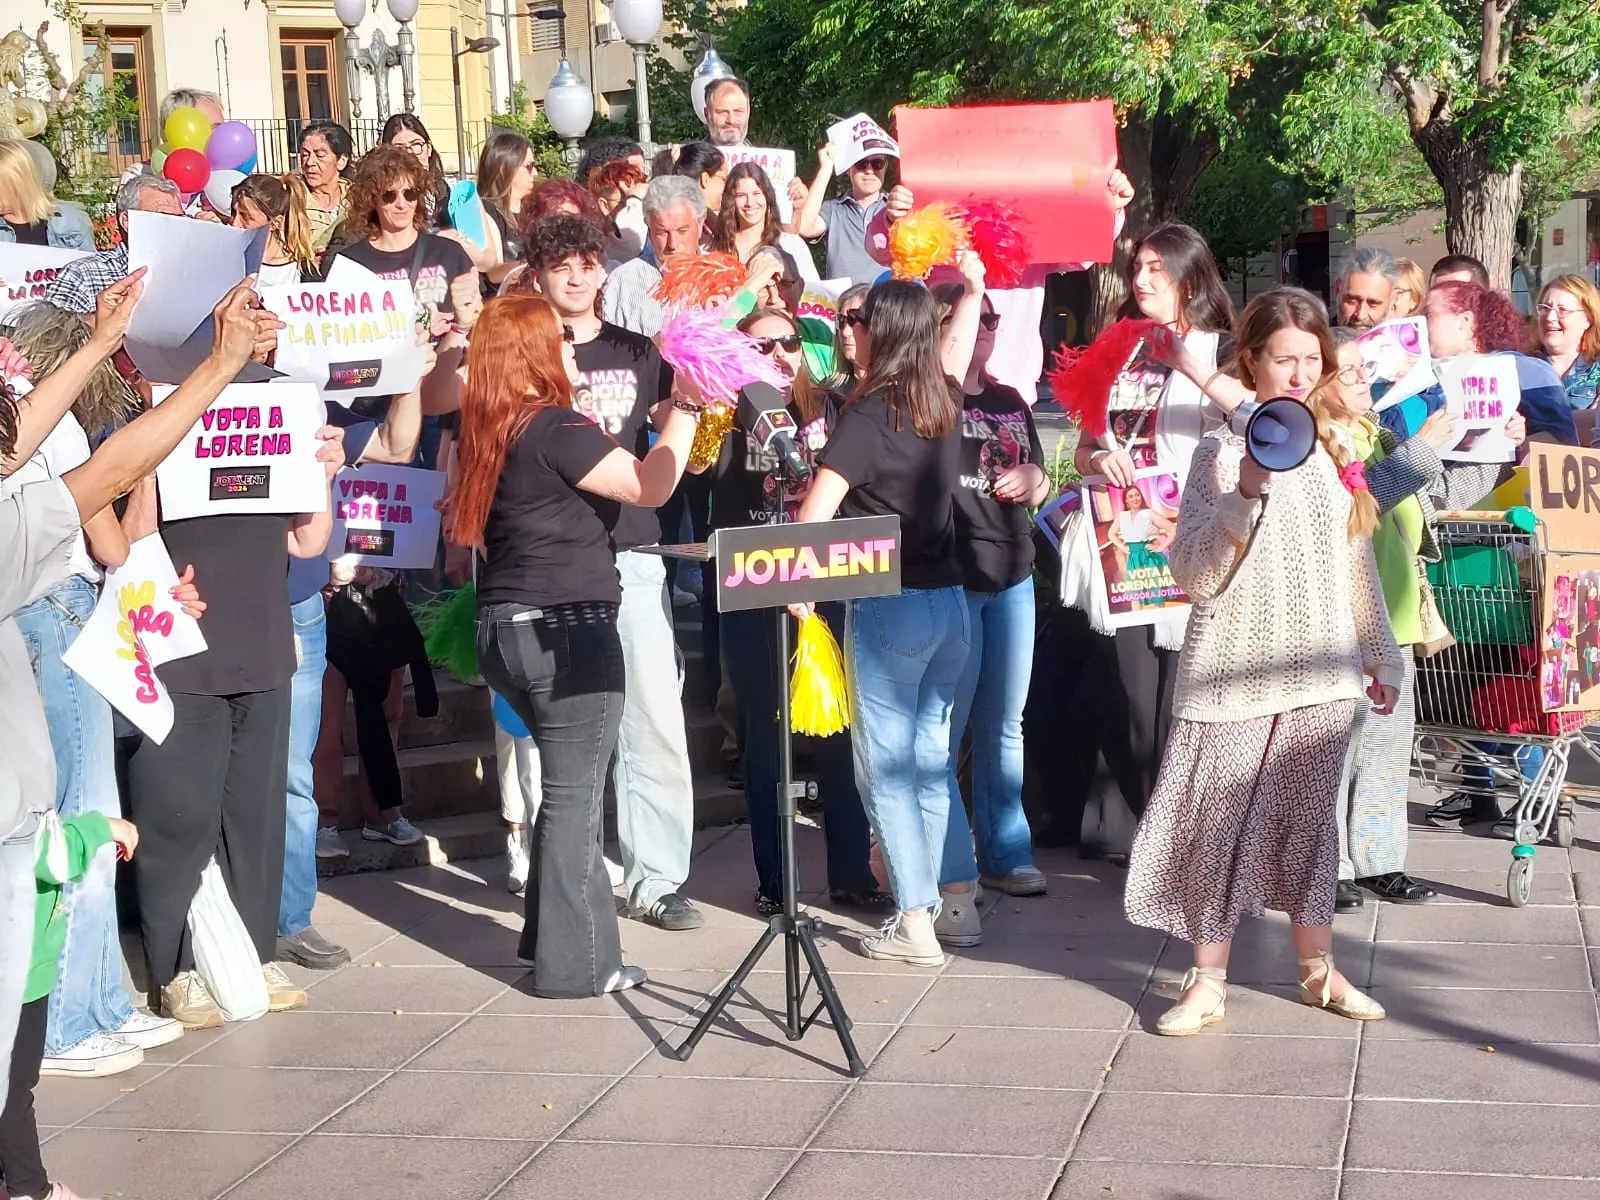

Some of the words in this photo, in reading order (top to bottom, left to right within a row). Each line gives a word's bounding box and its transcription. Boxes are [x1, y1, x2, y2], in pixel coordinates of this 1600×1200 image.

[287, 291, 372, 317] LORENA
[383, 290, 395, 311] A
[288, 321, 316, 346] LA
[591, 370, 638, 384] MATA
[201, 406, 261, 431] VOTA
[268, 405, 284, 429] A
[195, 433, 292, 458] LORENA
[213, 474, 266, 487] JOTALENT
[339, 480, 389, 499] VOTA
[394, 484, 407, 502] A
[1538, 454, 1600, 514] LOR
[336, 501, 413, 524] LORENA
[724, 538, 896, 588] JOTALENT
[1128, 567, 1160, 579] VOTA
[1162, 565, 1172, 576] A
[1111, 579, 1155, 594] LORENA
[1111, 590, 1157, 604] GANADORA
